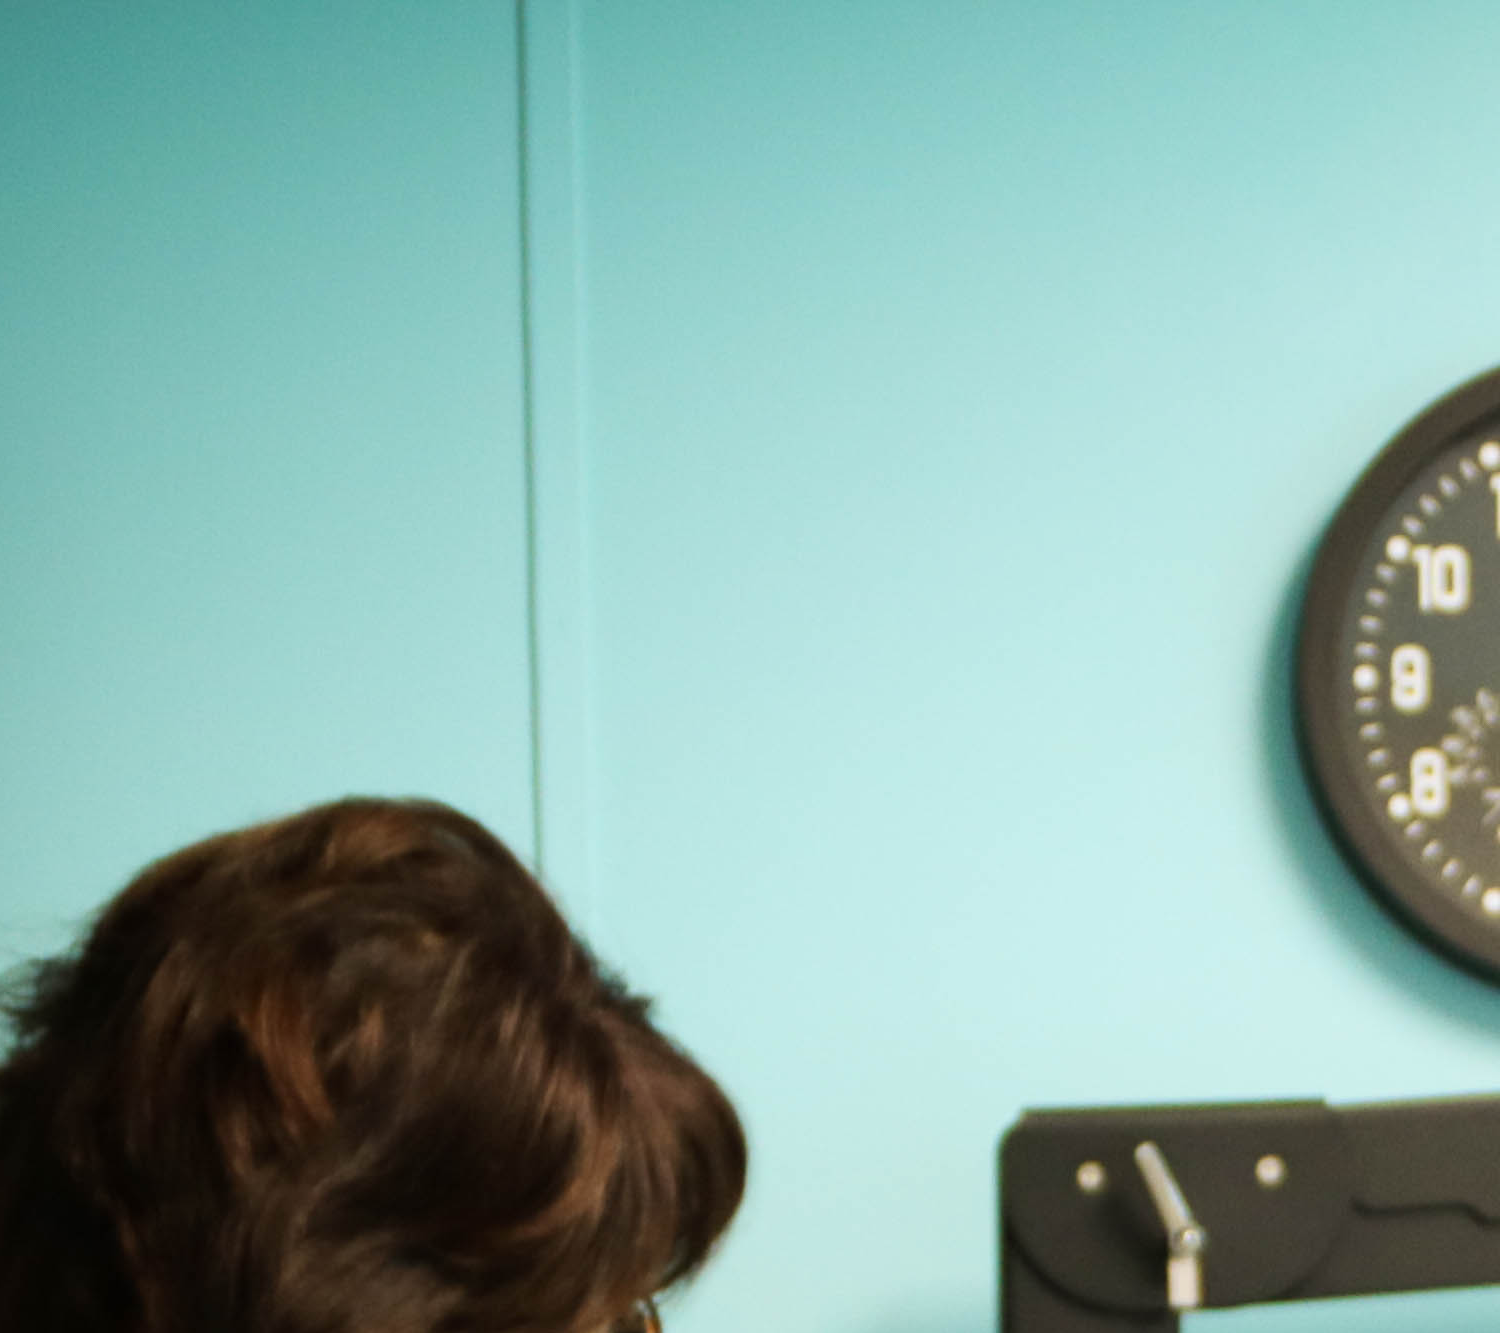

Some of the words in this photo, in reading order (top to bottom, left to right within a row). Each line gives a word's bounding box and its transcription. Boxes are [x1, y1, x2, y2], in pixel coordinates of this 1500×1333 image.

[1410, 544, 1472, 615] 10
[1389, 643, 1432, 714] 9
[1409, 745, 1452, 817] 8
